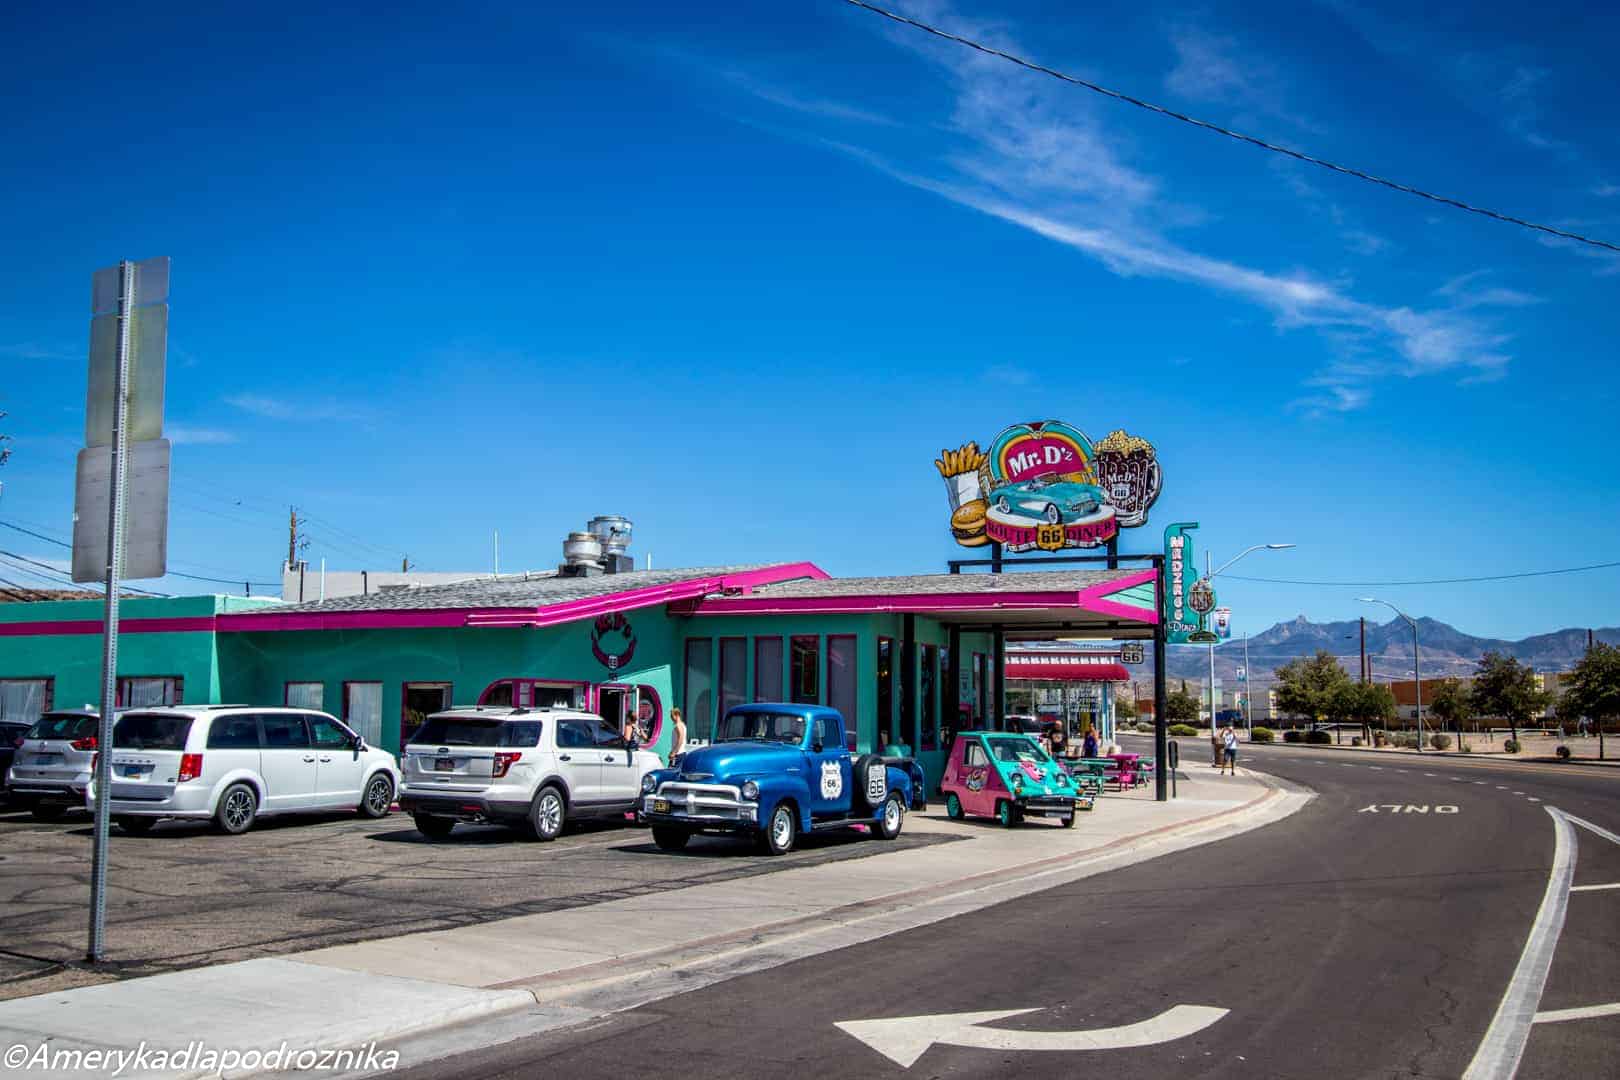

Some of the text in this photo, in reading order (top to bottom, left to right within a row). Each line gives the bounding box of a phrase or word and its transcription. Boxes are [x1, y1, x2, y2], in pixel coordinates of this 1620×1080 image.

[1008, 446, 1073, 477] Mr. D'z
[1042, 530, 1060, 543] 66
[1066, 519, 1113, 539] DINER
[1123, 651, 1140, 661] 66
[827, 779, 837, 788] 66
[870, 779, 884, 794] 66
[1358, 804, 1460, 814] ONLY
